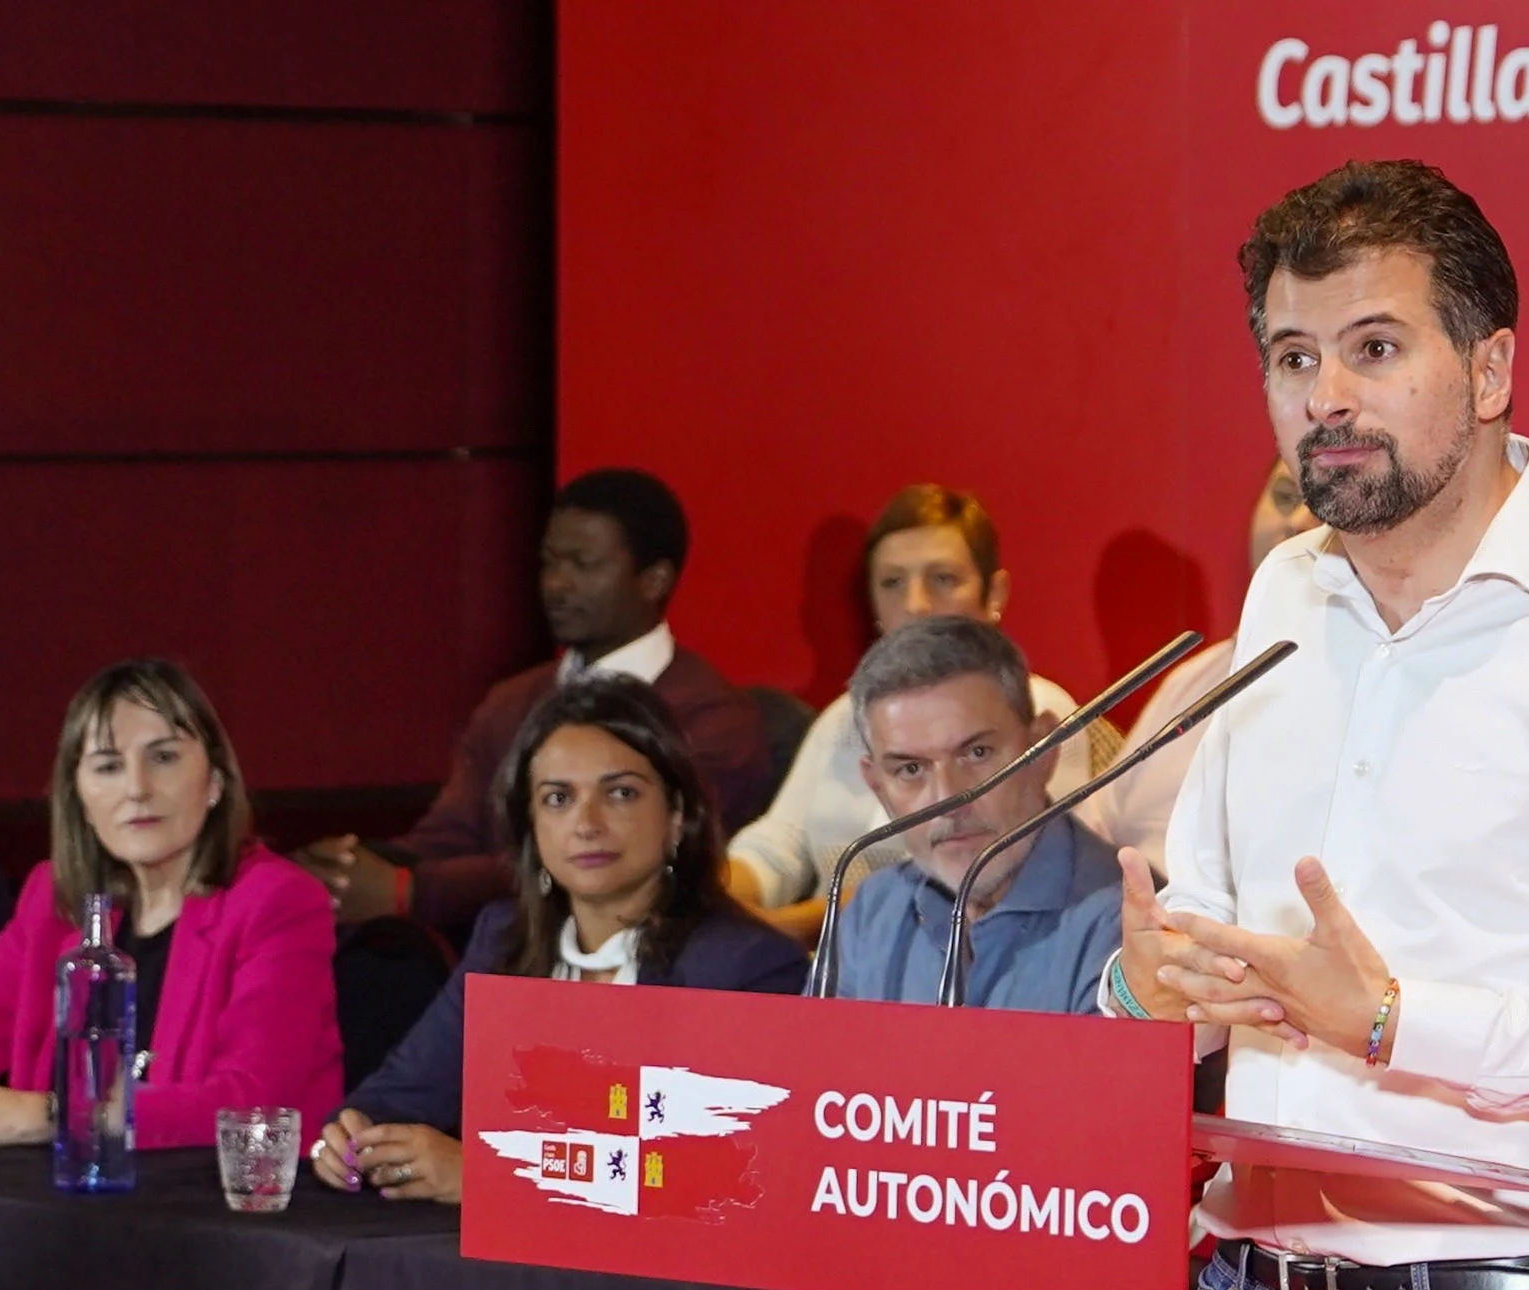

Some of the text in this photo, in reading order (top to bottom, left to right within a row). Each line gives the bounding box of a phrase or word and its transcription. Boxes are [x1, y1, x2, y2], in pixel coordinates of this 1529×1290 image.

[813, 1090, 998, 1153] COMITÉ
[542, 1158, 566, 1173] PSOE
[809, 1166, 1152, 1244] AUTONÓMICO
